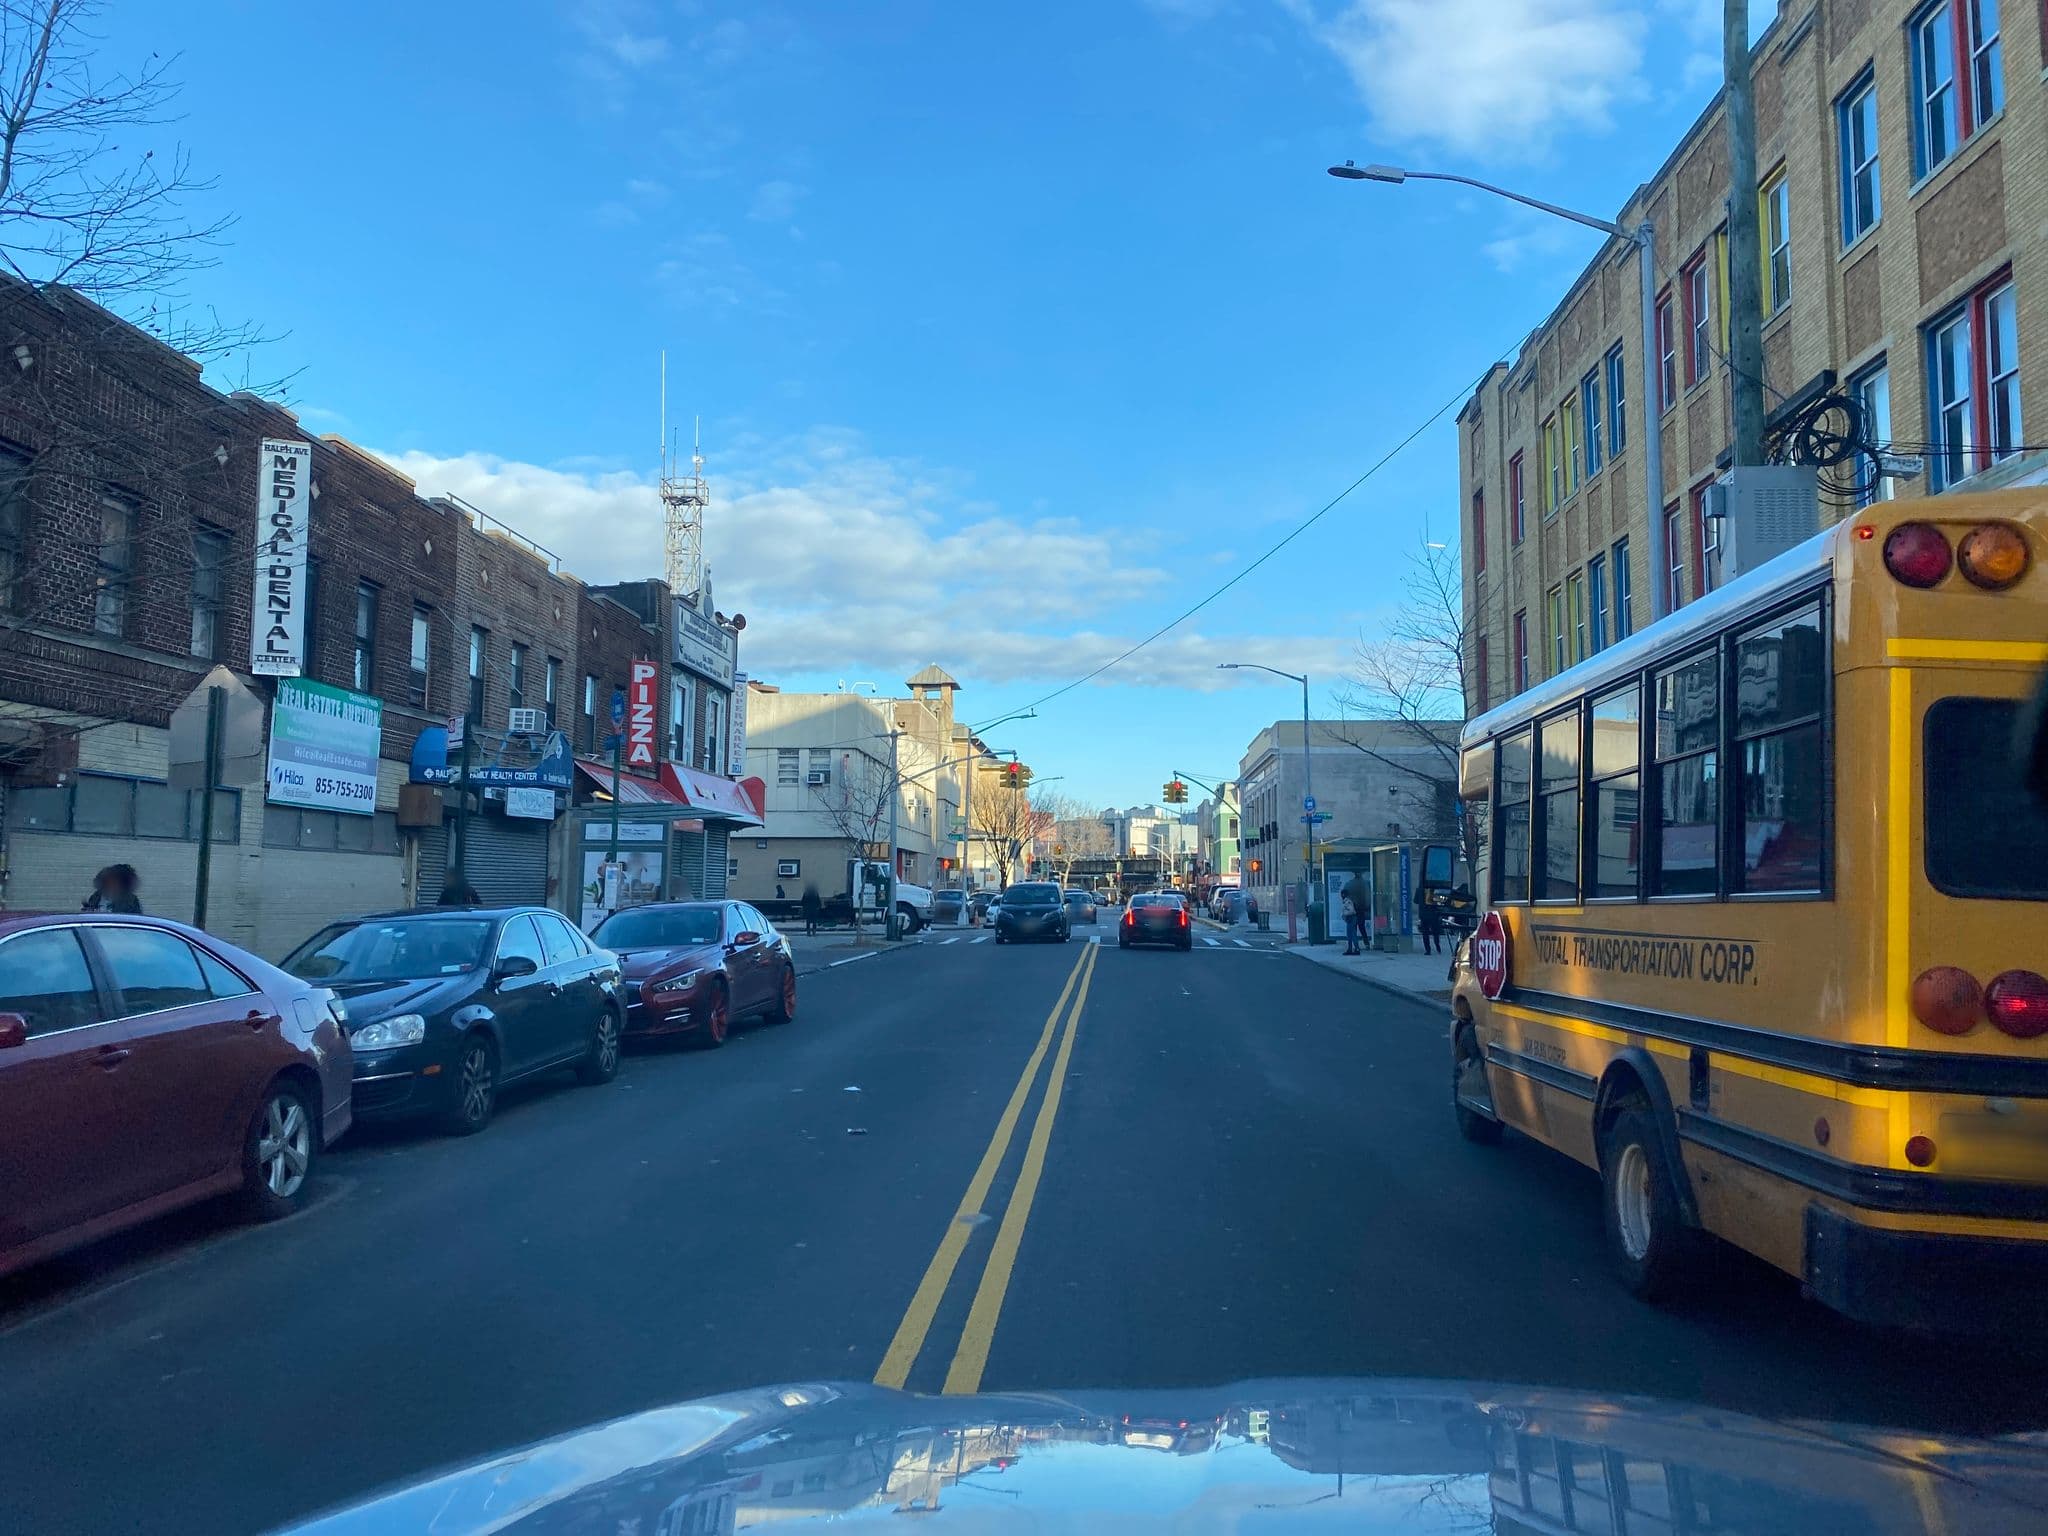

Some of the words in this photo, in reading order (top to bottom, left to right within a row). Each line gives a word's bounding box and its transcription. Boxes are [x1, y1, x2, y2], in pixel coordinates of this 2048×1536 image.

[294, 446, 309, 456] AVE
[256, 654, 296, 664] CENTER
[281, 686, 305, 710] REAL
[308, 692, 341, 718] ESTATE
[342, 702, 379, 728] AUCTION
[630, 664, 656, 763] PIZZA
[733, 683, 744, 763] SUPERMARKET
[284, 769, 304, 786] Hilco
[315, 777, 374, 801] 855-755-2300
[491, 771, 513, 780] HEALTH
[514, 772, 538, 781] CENTER
[1478, 939, 1502, 972] STOP
[1538, 935, 1569, 965] TOTAL
[1573, 936, 1695, 980] TRANSPORTATION
[1700, 942, 1758, 987] CORP.
